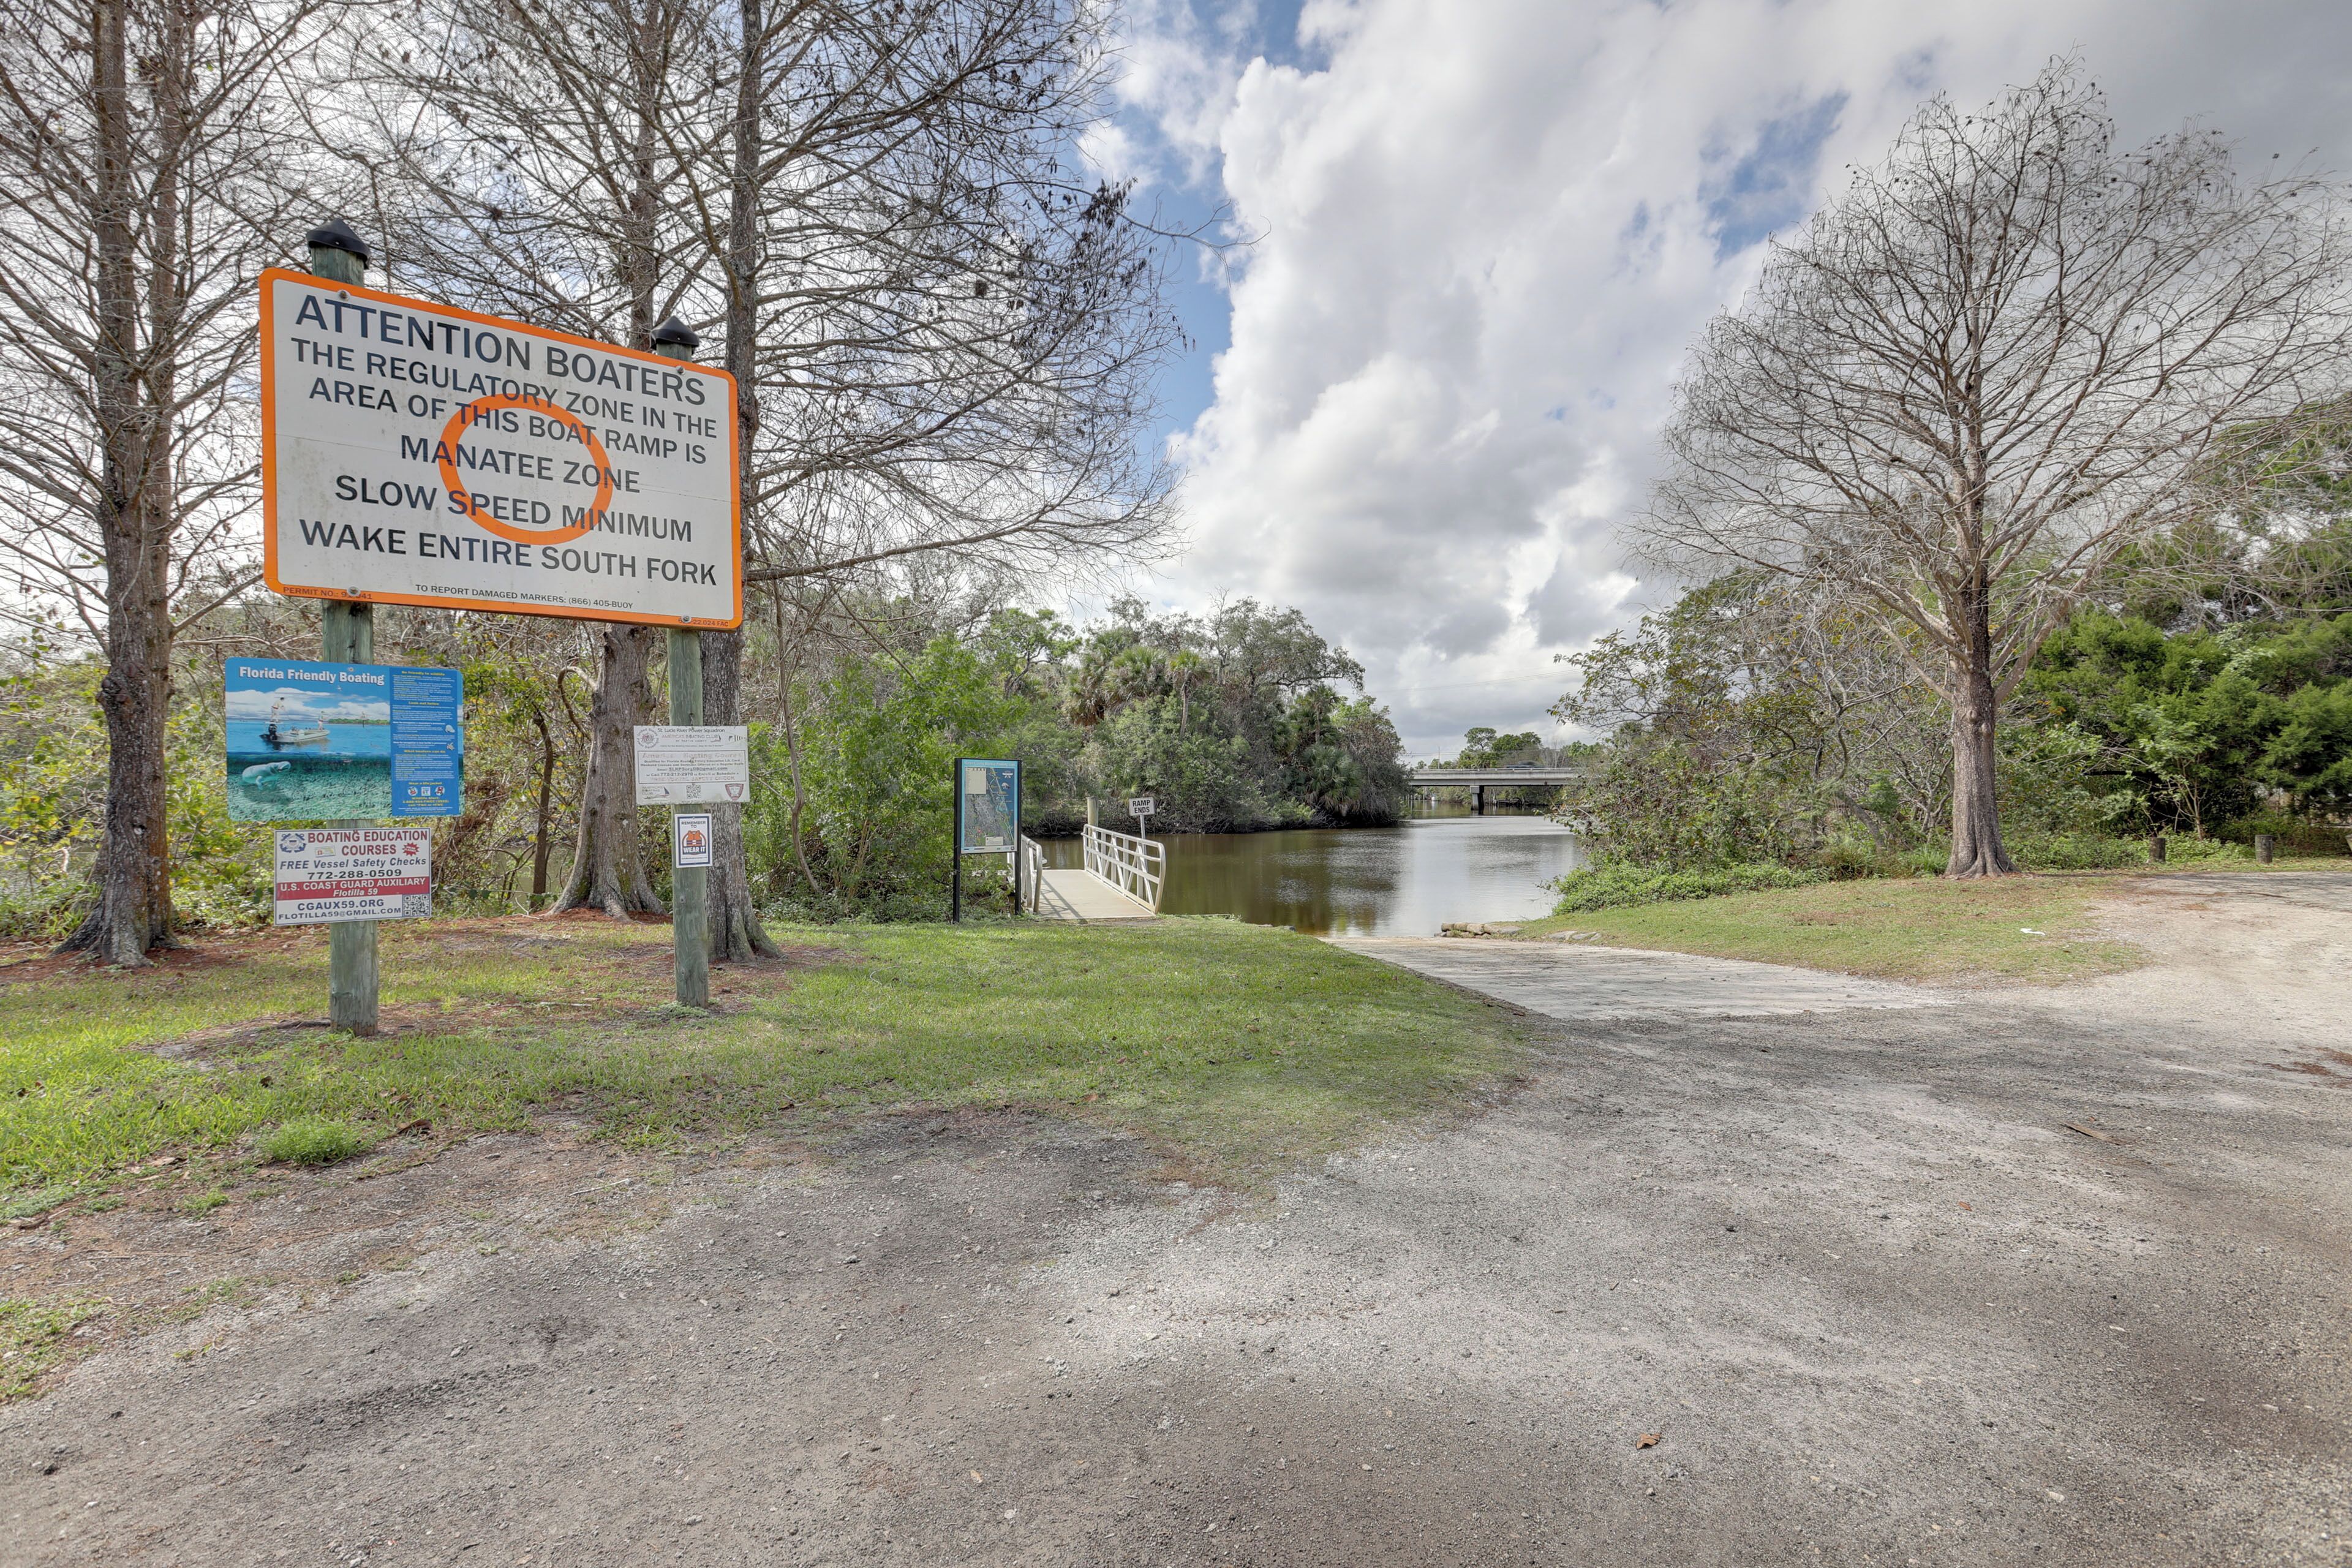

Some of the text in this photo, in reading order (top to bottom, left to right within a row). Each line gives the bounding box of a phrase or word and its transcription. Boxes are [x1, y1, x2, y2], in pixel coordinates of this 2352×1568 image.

[296, 295, 705, 405] ATTENTION BOATERS
[291, 337, 717, 438] THE REGULATORY ZONE IN THE
[309, 377, 706, 464] AREA OF THIS BOAT RAMP IS
[402, 435, 639, 492] MANATEE ZONE
[335, 475, 691, 542] SLOW SPEED MINIMUM
[300, 519, 716, 586] WAKE ENTIRE SOUTH FORK
[431, 586, 469, 595] REPORT
[472, 589, 518, 598] DAMAGED
[521, 593, 566, 603] MARKERS:
[568, 597, 590, 606] (866)
[594, 600, 633, 609] 405-BUOY
[239, 667, 284, 680] Florida
[287, 669, 337, 684] Friendly
[339, 672, 385, 685] Boating
[308, 831, 428, 843] BOATING EDUCATION
[342, 845, 396, 856] COURSES
[280, 860, 309, 870] FREE
[314, 860, 349, 869] Vessel
[353, 859, 386, 868] Safety
[307, 869, 402, 880] 772-288-0509
[303, 881, 337, 890] COAST
[377, 878, 425, 886] AUXILIARY
[279, 908, 401, 920] FLOTILLA59@GMAIL.COM
[298, 899, 384, 911] CGAUX59.ORG
